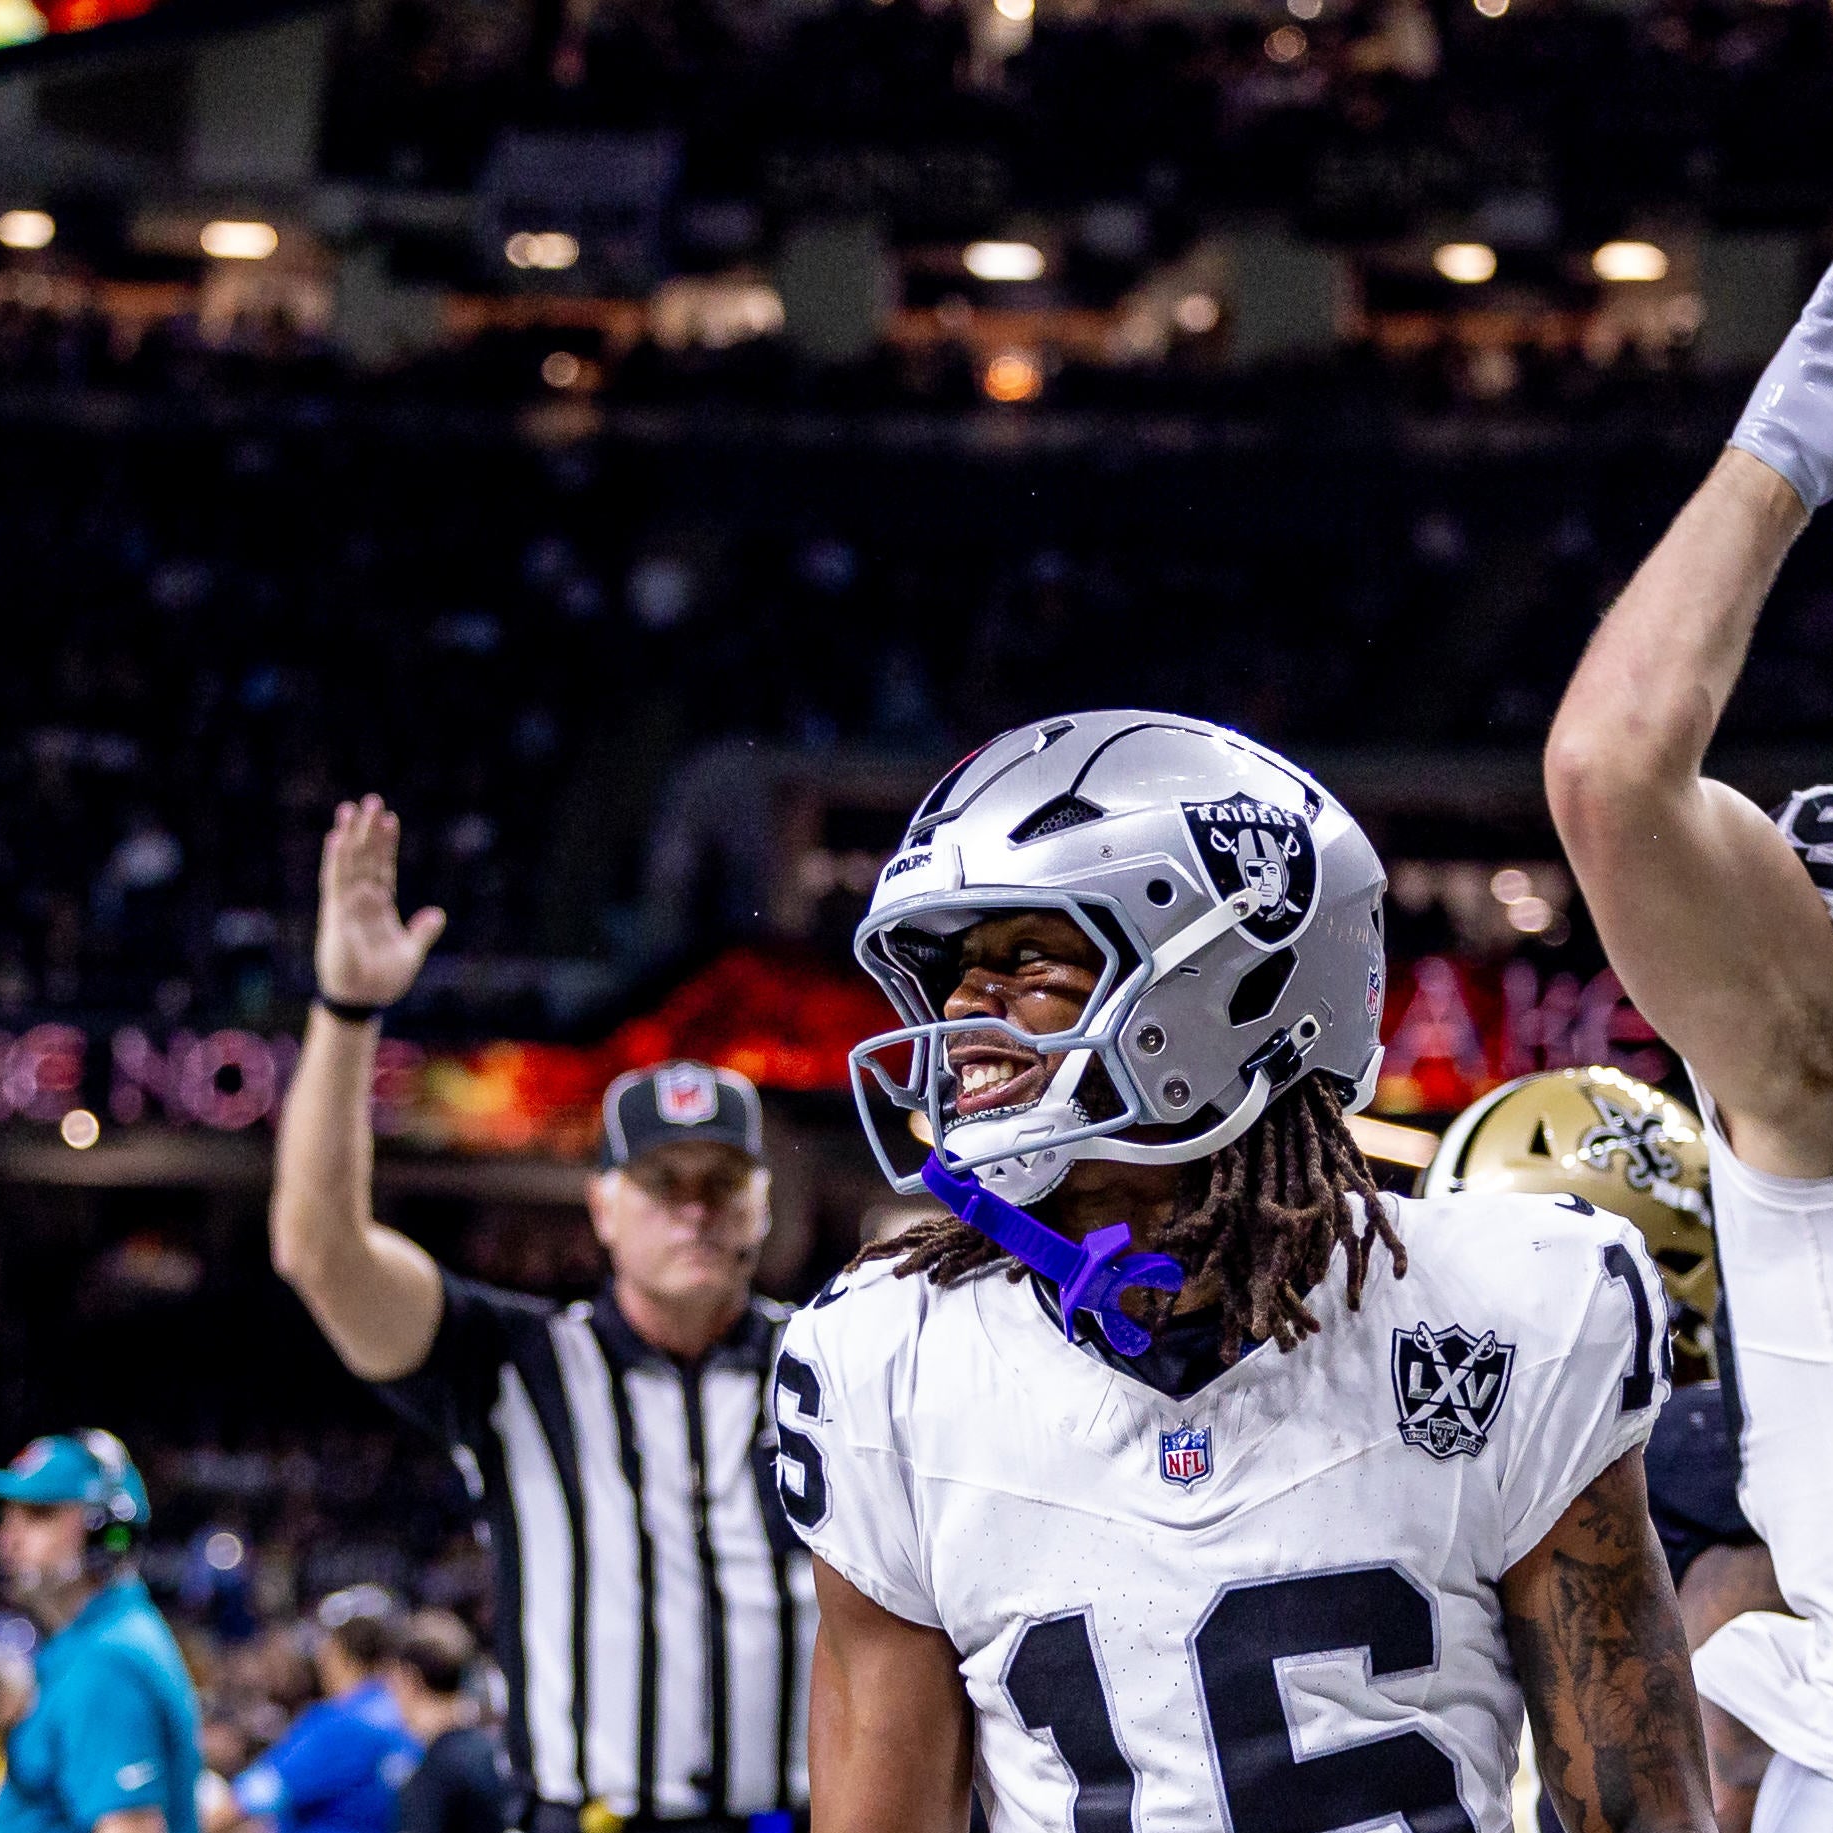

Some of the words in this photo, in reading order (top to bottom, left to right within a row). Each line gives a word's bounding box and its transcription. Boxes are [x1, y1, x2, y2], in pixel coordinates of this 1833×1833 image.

[1196, 806, 1297, 828] RAIDERS
[1408, 1361, 1500, 1409] LXV
[1167, 1451, 1205, 1477] NFL
